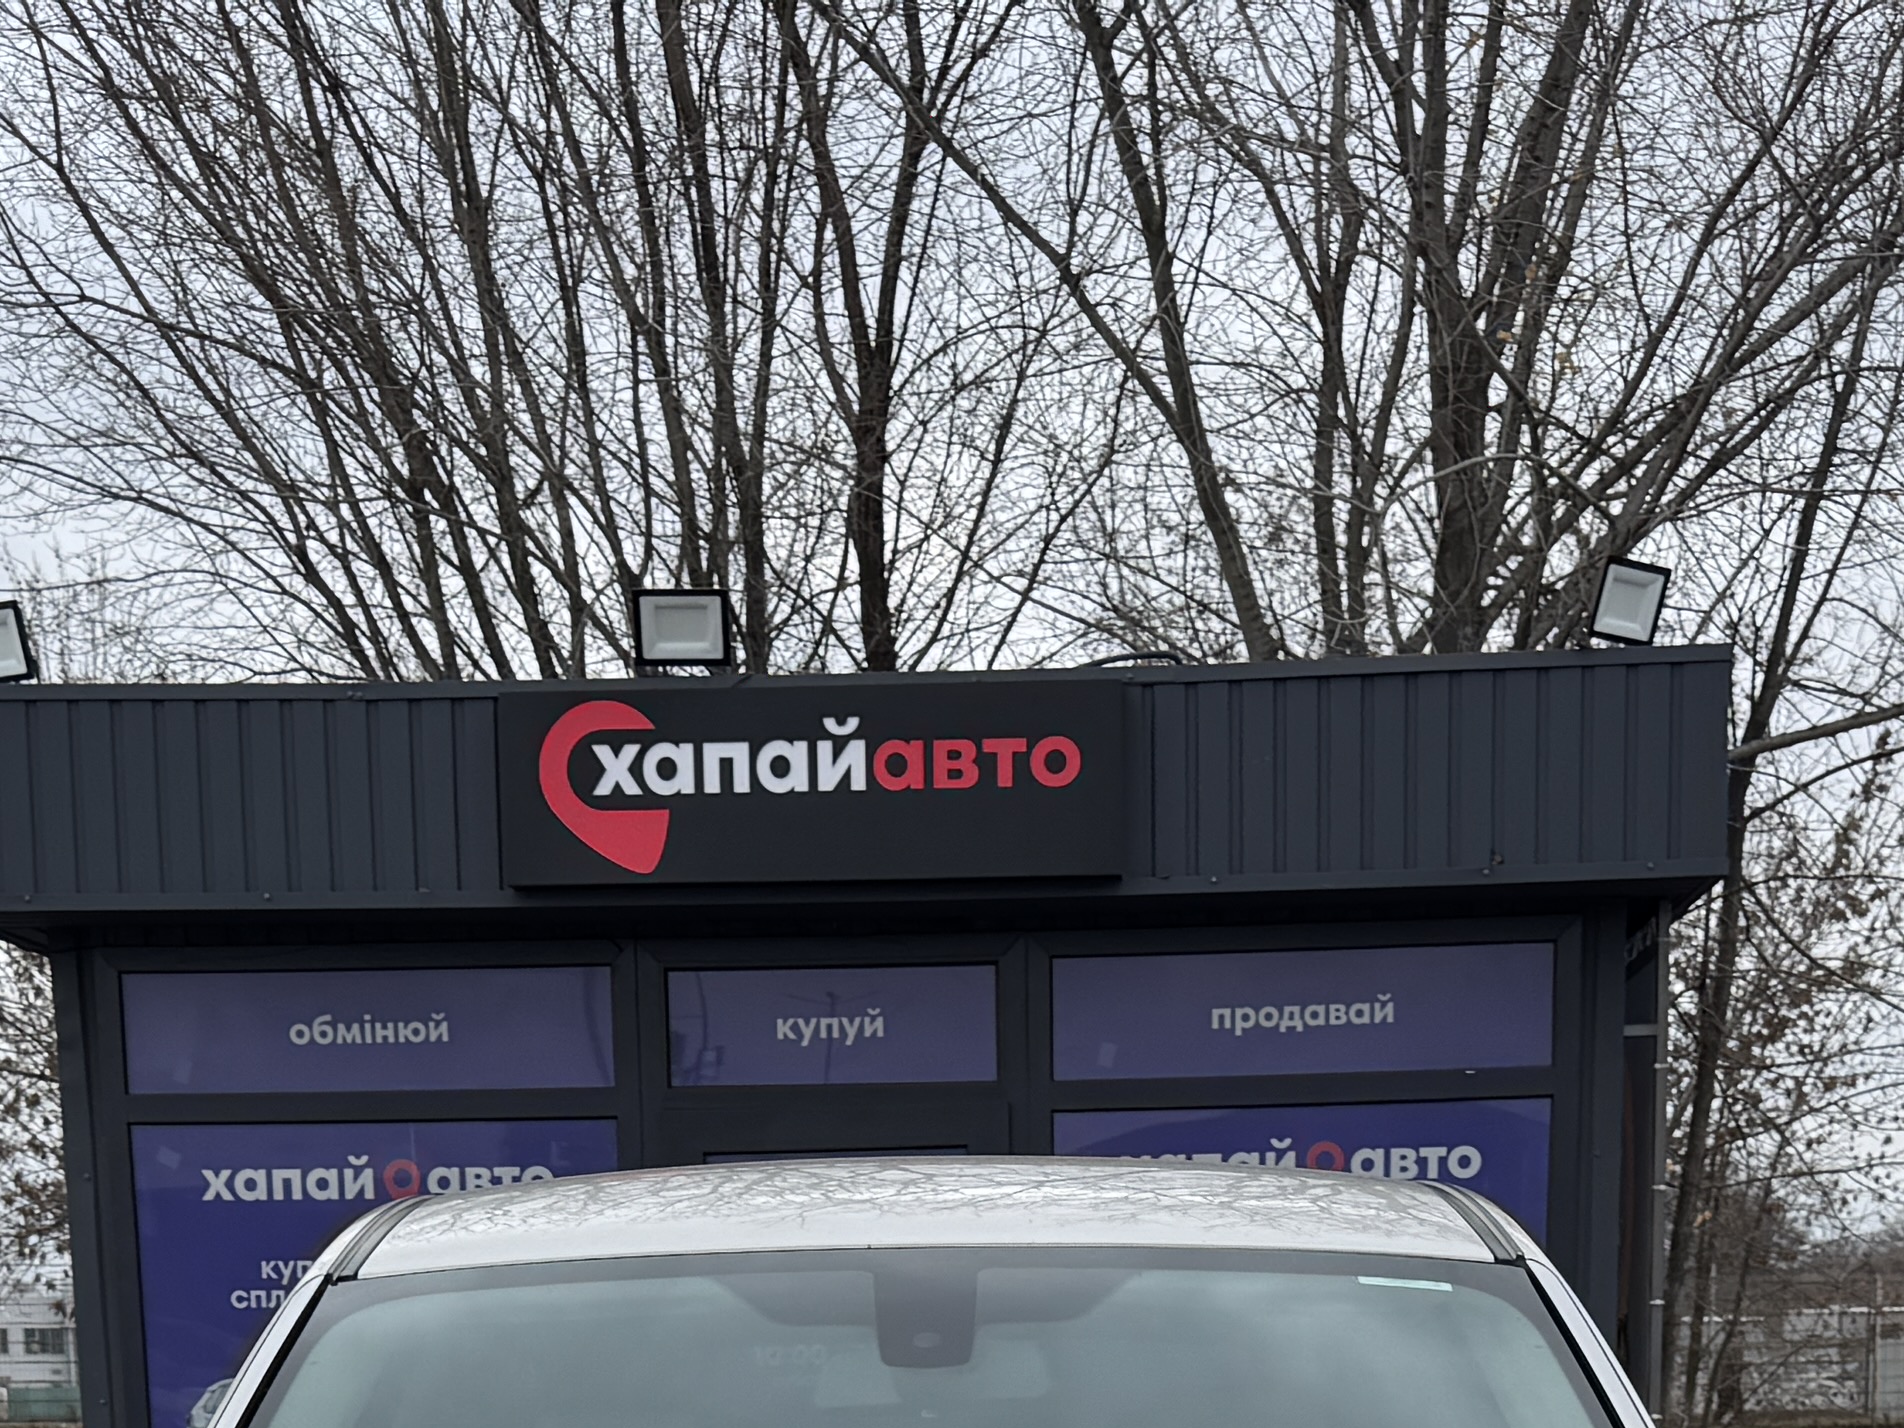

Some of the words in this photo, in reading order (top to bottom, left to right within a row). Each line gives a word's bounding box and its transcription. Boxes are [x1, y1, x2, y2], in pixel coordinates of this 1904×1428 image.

[289, 1012, 449, 1046] обмінюй
[776, 1008, 885, 1046] купуй
[1211, 993, 1395, 1036] продавай
[201, 1155, 375, 1201] хапай
[1350, 1144, 1482, 1180] авто
[260, 1259, 313, 1286] куп
[230, 1289, 286, 1310] спл
